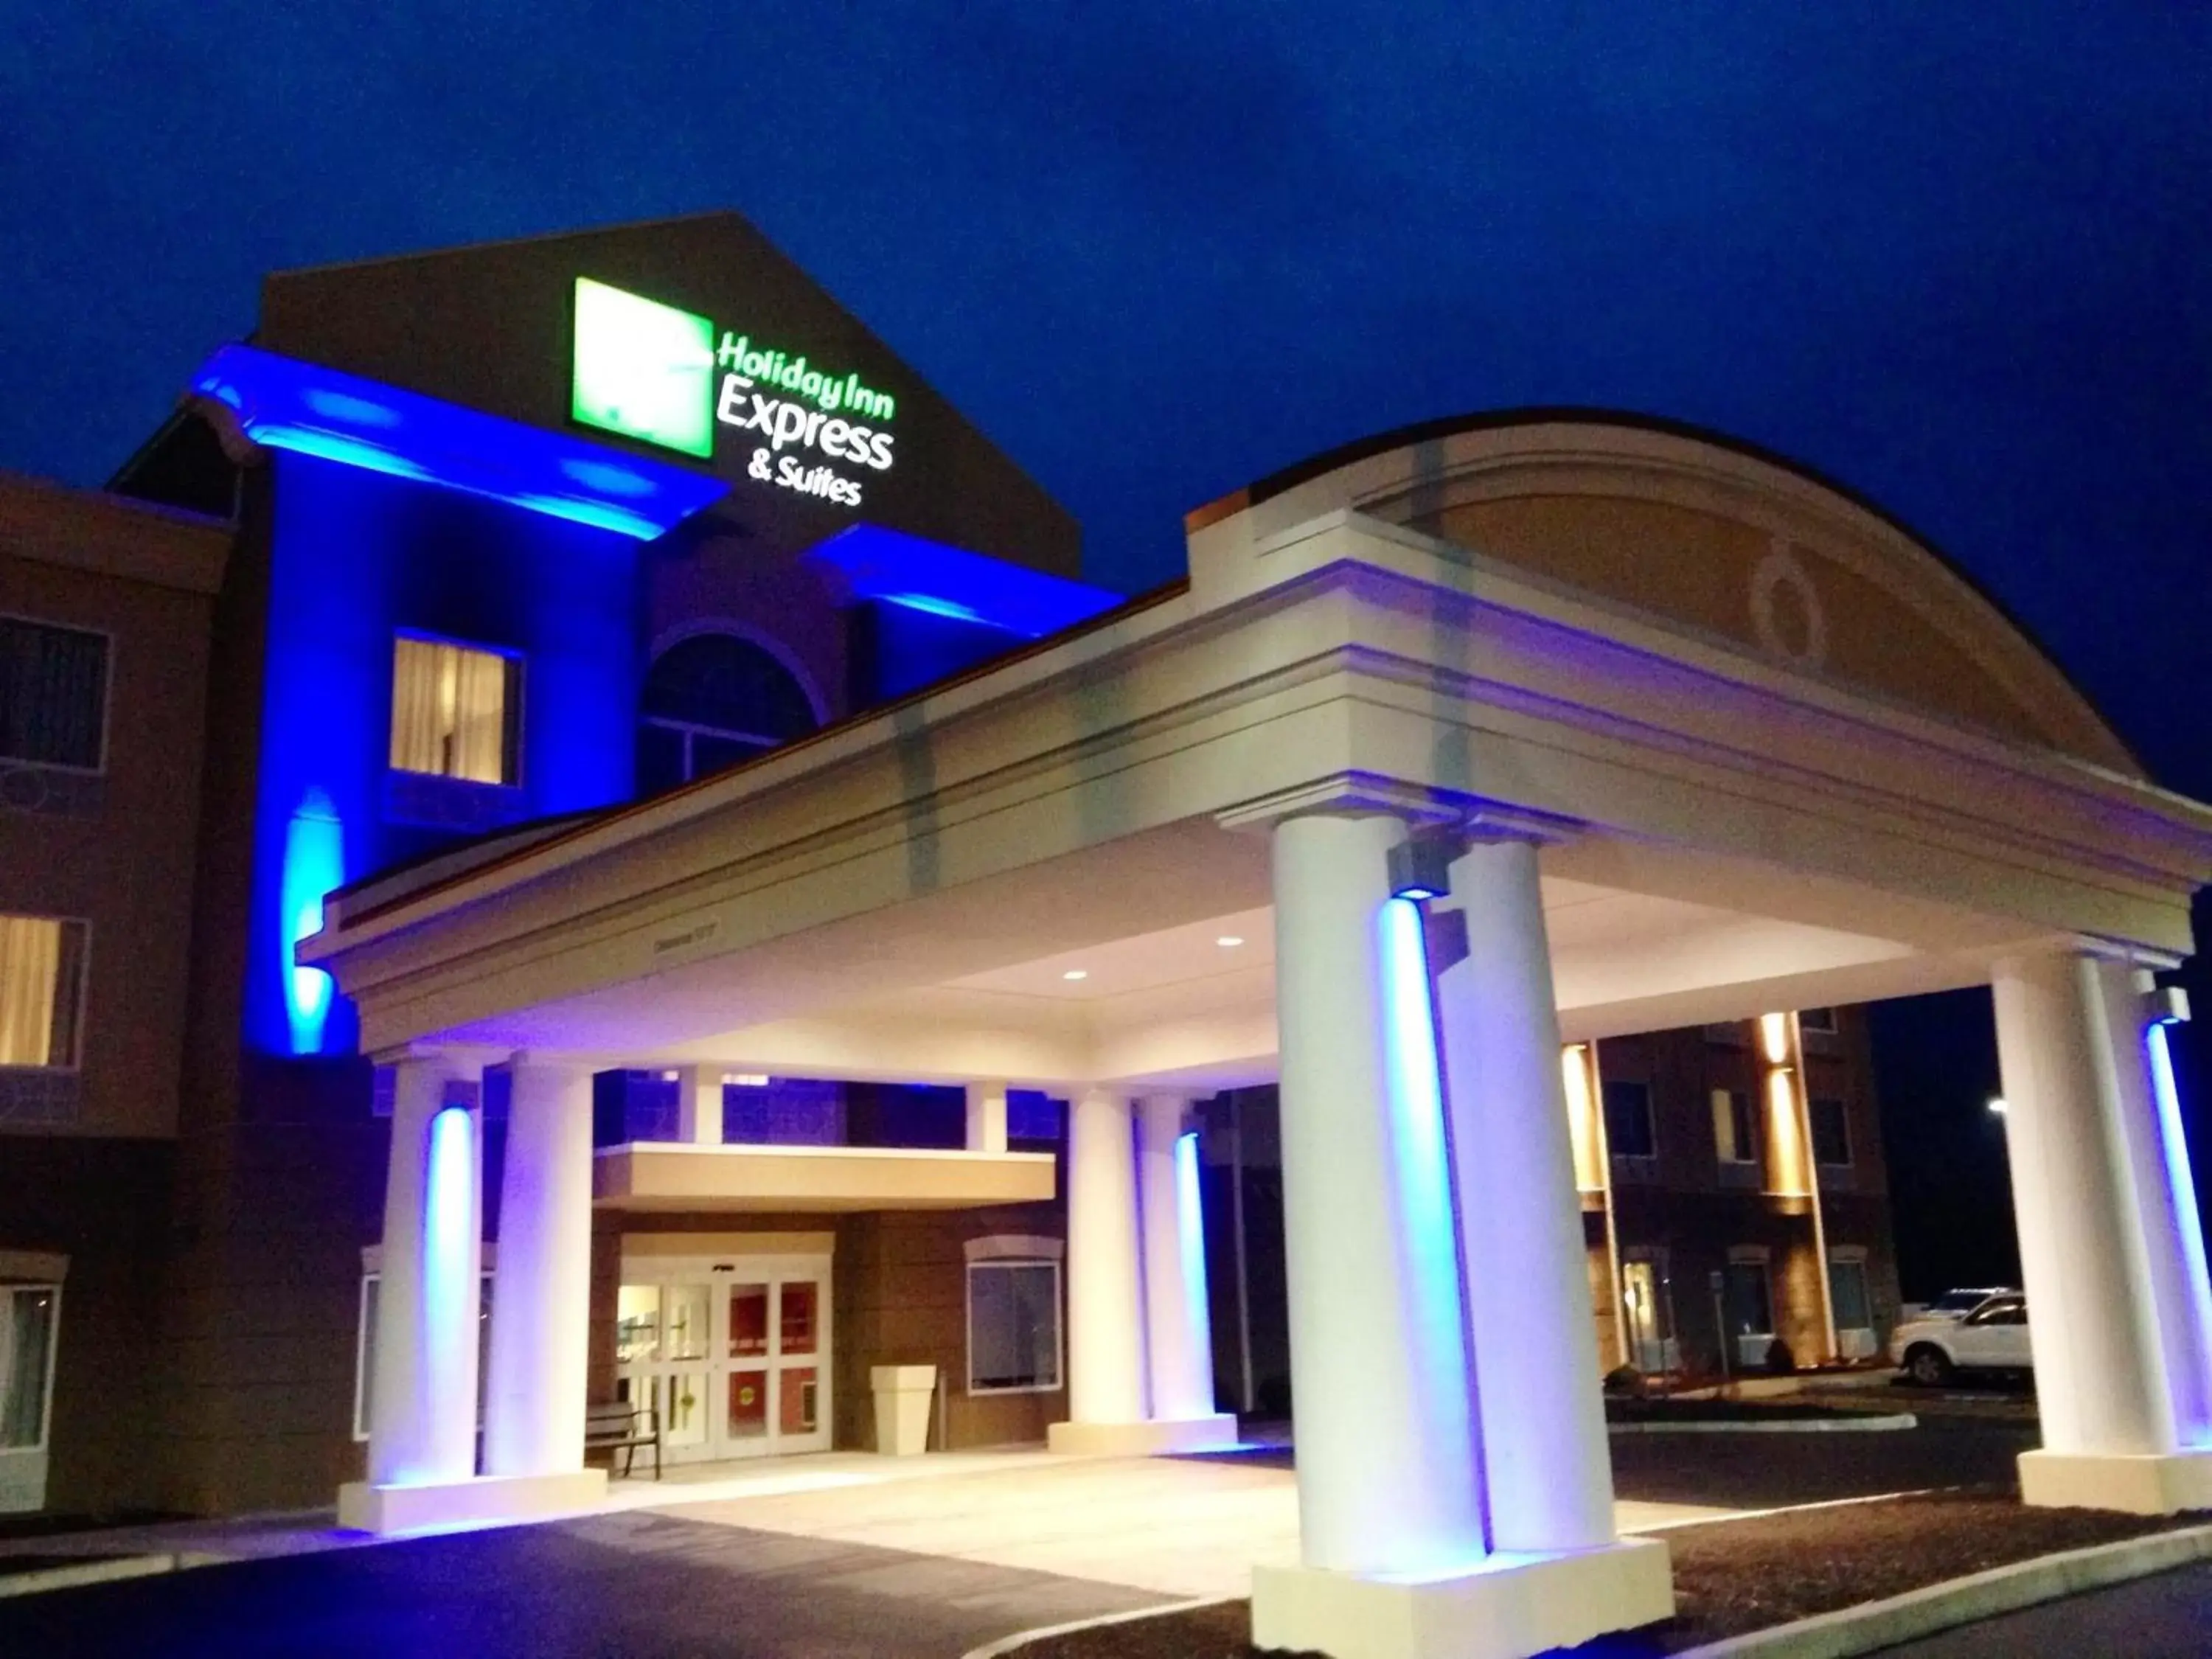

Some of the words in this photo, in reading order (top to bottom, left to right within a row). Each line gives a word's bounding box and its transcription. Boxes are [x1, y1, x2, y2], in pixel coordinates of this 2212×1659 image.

[717, 373, 894, 470] Express
[747, 448, 771, 481] &
[776, 456, 862, 507] Suites
